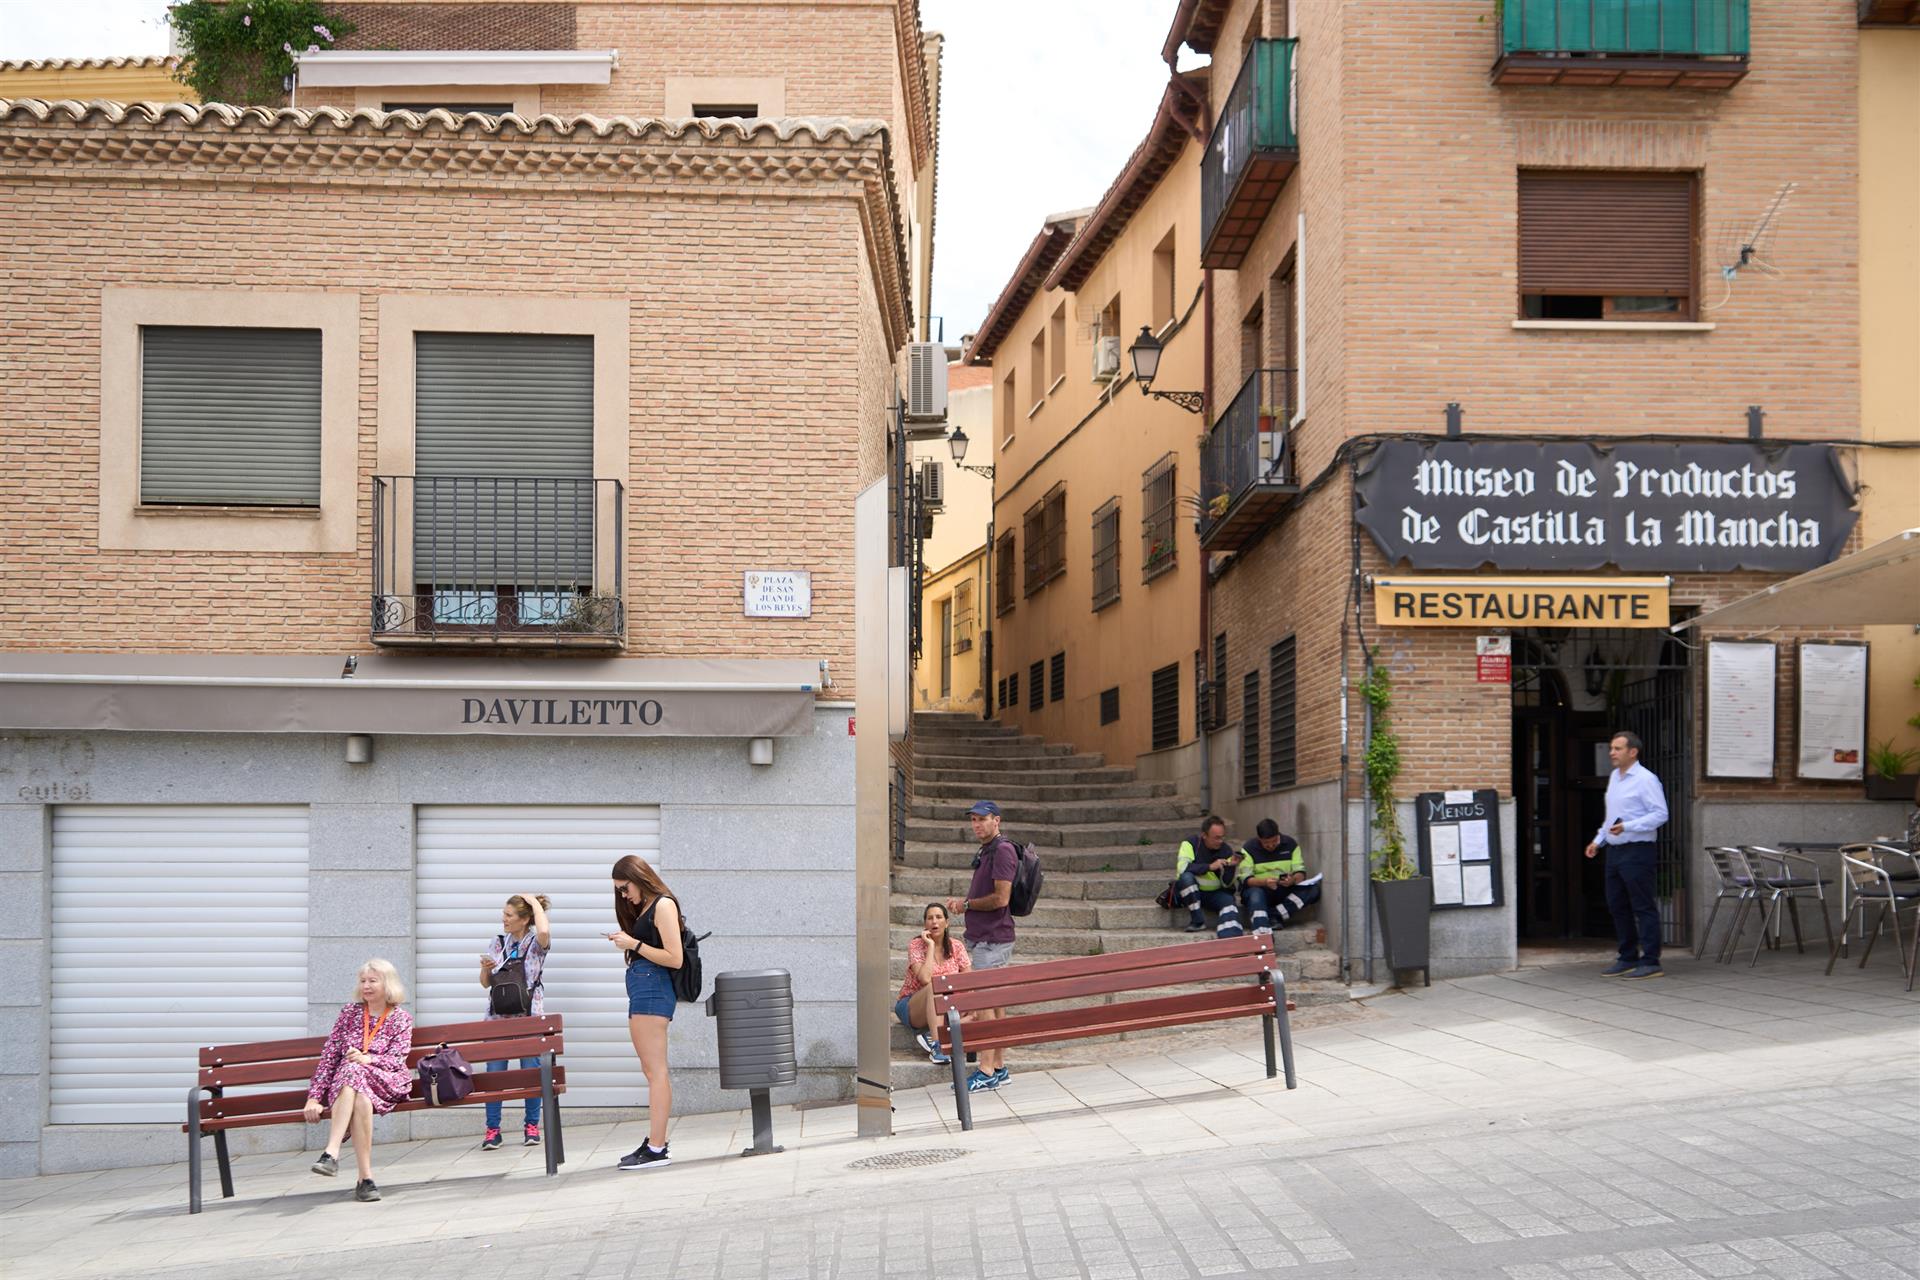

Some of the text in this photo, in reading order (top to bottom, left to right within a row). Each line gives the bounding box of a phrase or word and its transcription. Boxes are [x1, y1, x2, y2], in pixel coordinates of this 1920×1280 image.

[1413, 459, 1797, 500] Museo de Productos
[1401, 505, 1820, 548] de Castilla la Mancha
[762, 585, 794, 593] DE SAN
[763, 576, 793, 584] PLAZA
[759, 594, 796, 602] JUAN DE
[1394, 592, 1650, 620] RESTAURANTE
[755, 604, 803, 612] LOS REYES
[461, 698, 663, 726] DAVILETTO
